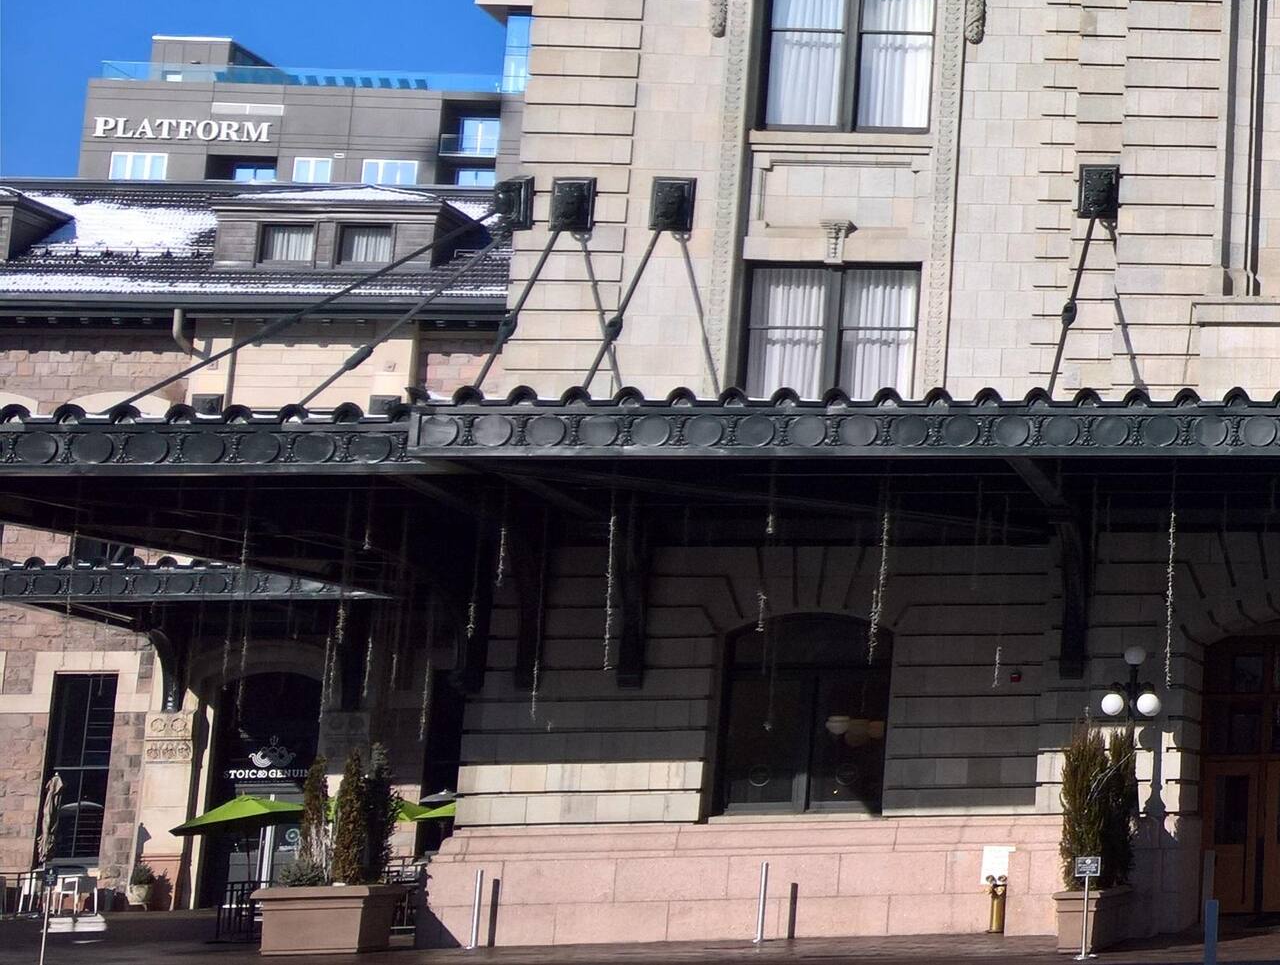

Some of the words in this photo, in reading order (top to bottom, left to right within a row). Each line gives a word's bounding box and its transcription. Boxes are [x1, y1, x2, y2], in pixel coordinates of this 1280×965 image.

[92, 116, 272, 143] PLATFORM
[223, 768, 257, 779] STOIC
[268, 768, 309, 779] GENUIN
